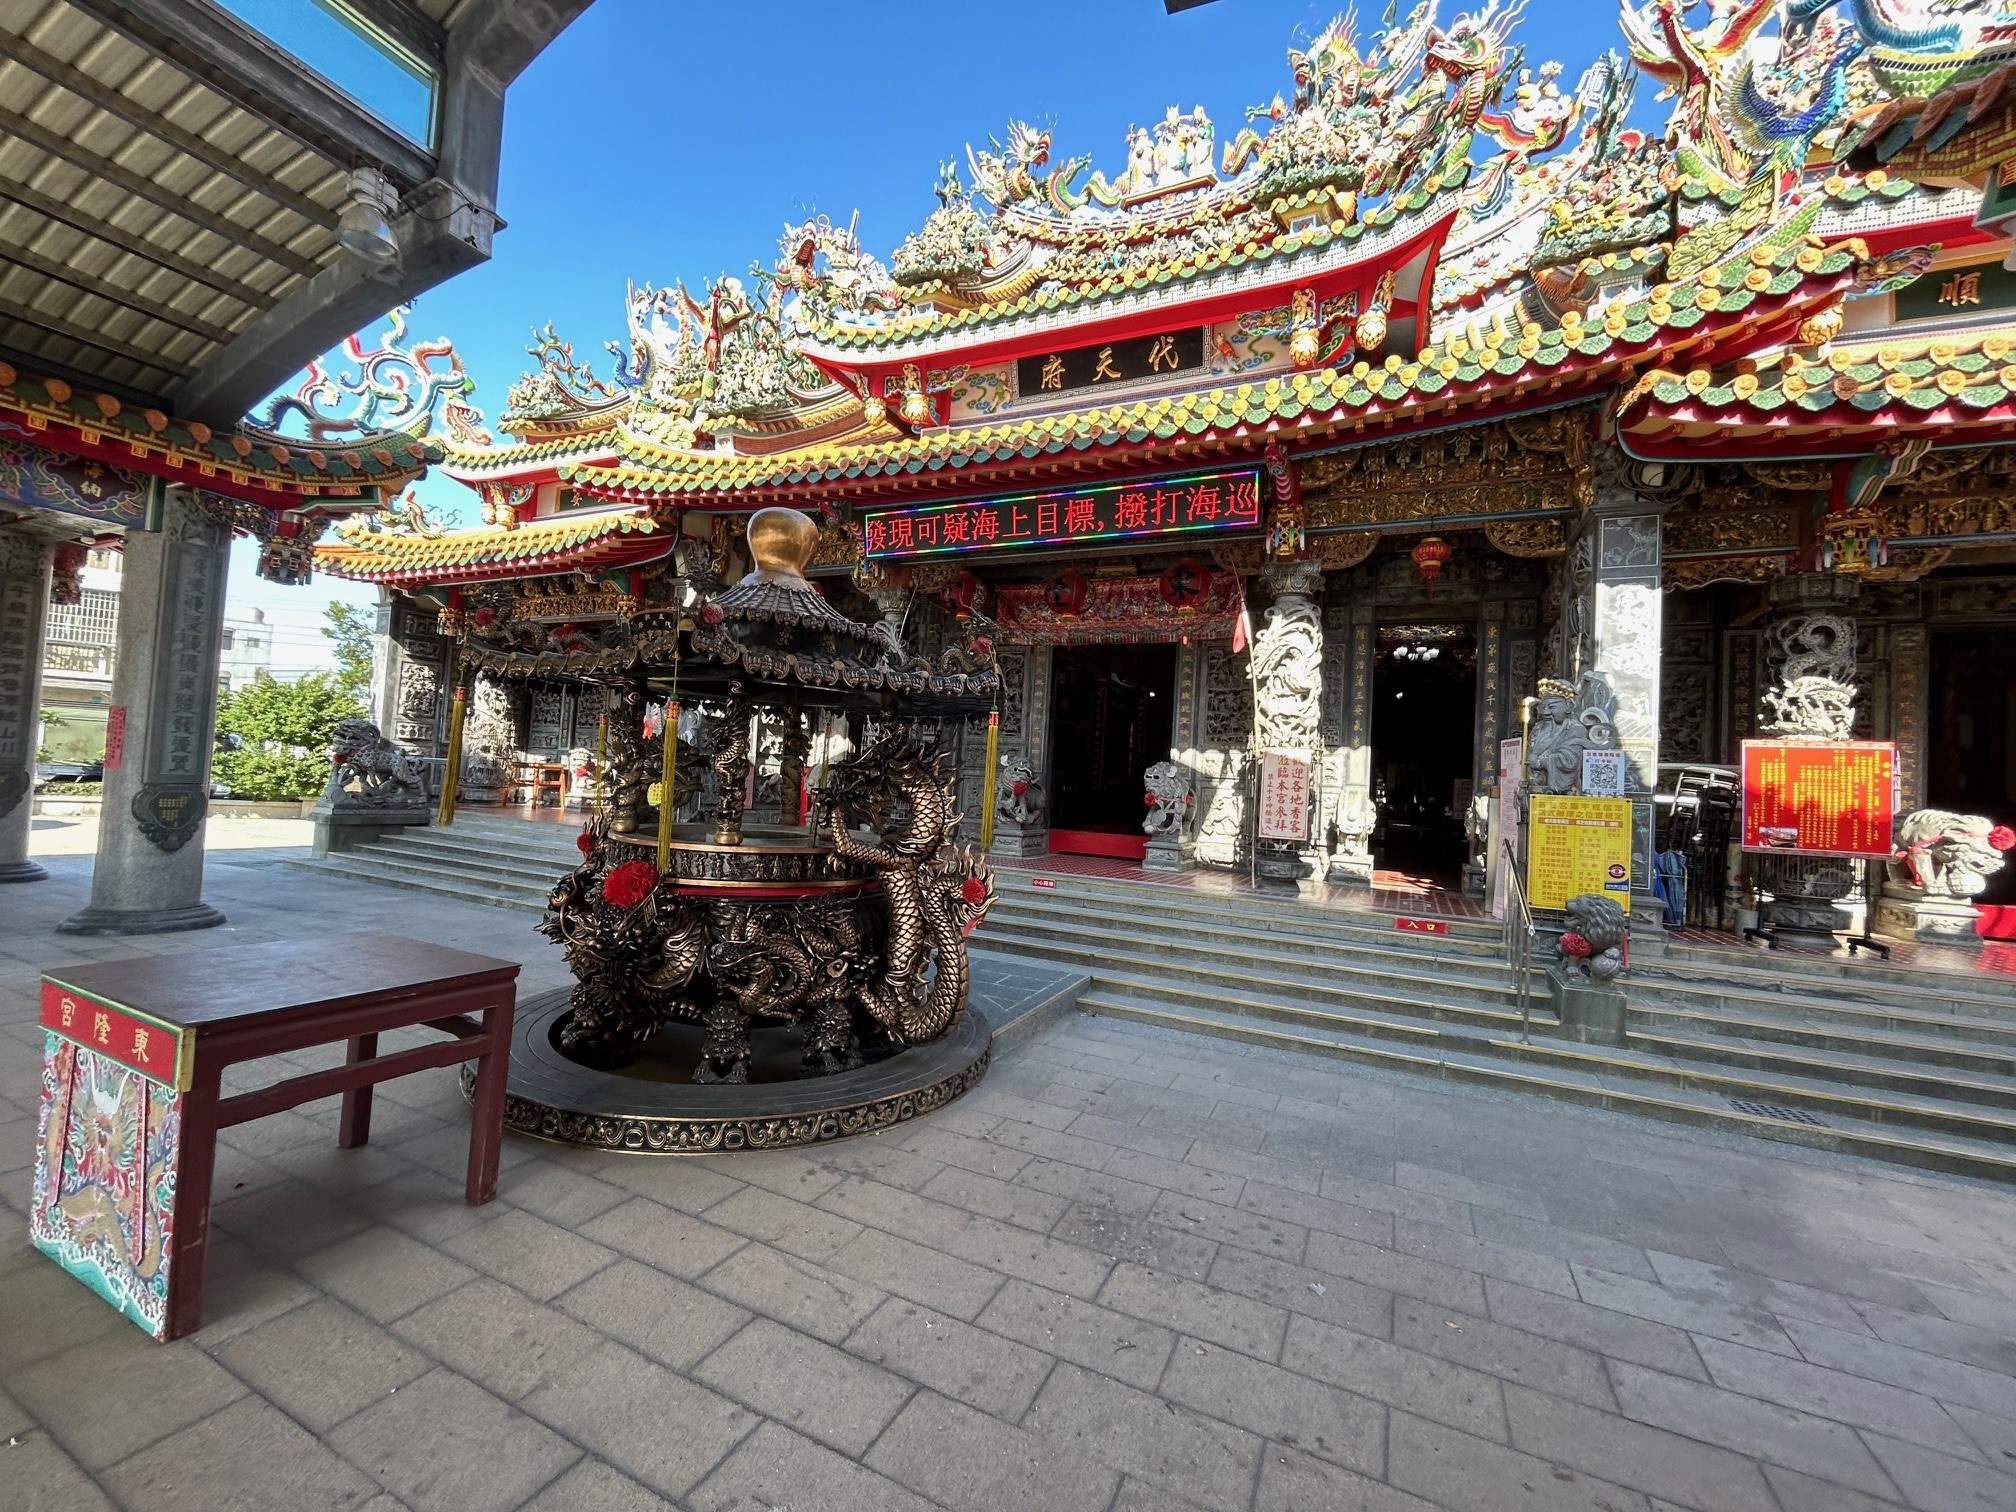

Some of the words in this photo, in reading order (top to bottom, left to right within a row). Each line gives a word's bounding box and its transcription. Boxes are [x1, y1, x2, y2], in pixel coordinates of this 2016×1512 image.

[1937, 271, 1982, 307] 順
[1040, 334, 1180, 391] 代天府
[1407, 920, 1436, 931] 入口
[60, 997, 150, 1063] 東隆宮
